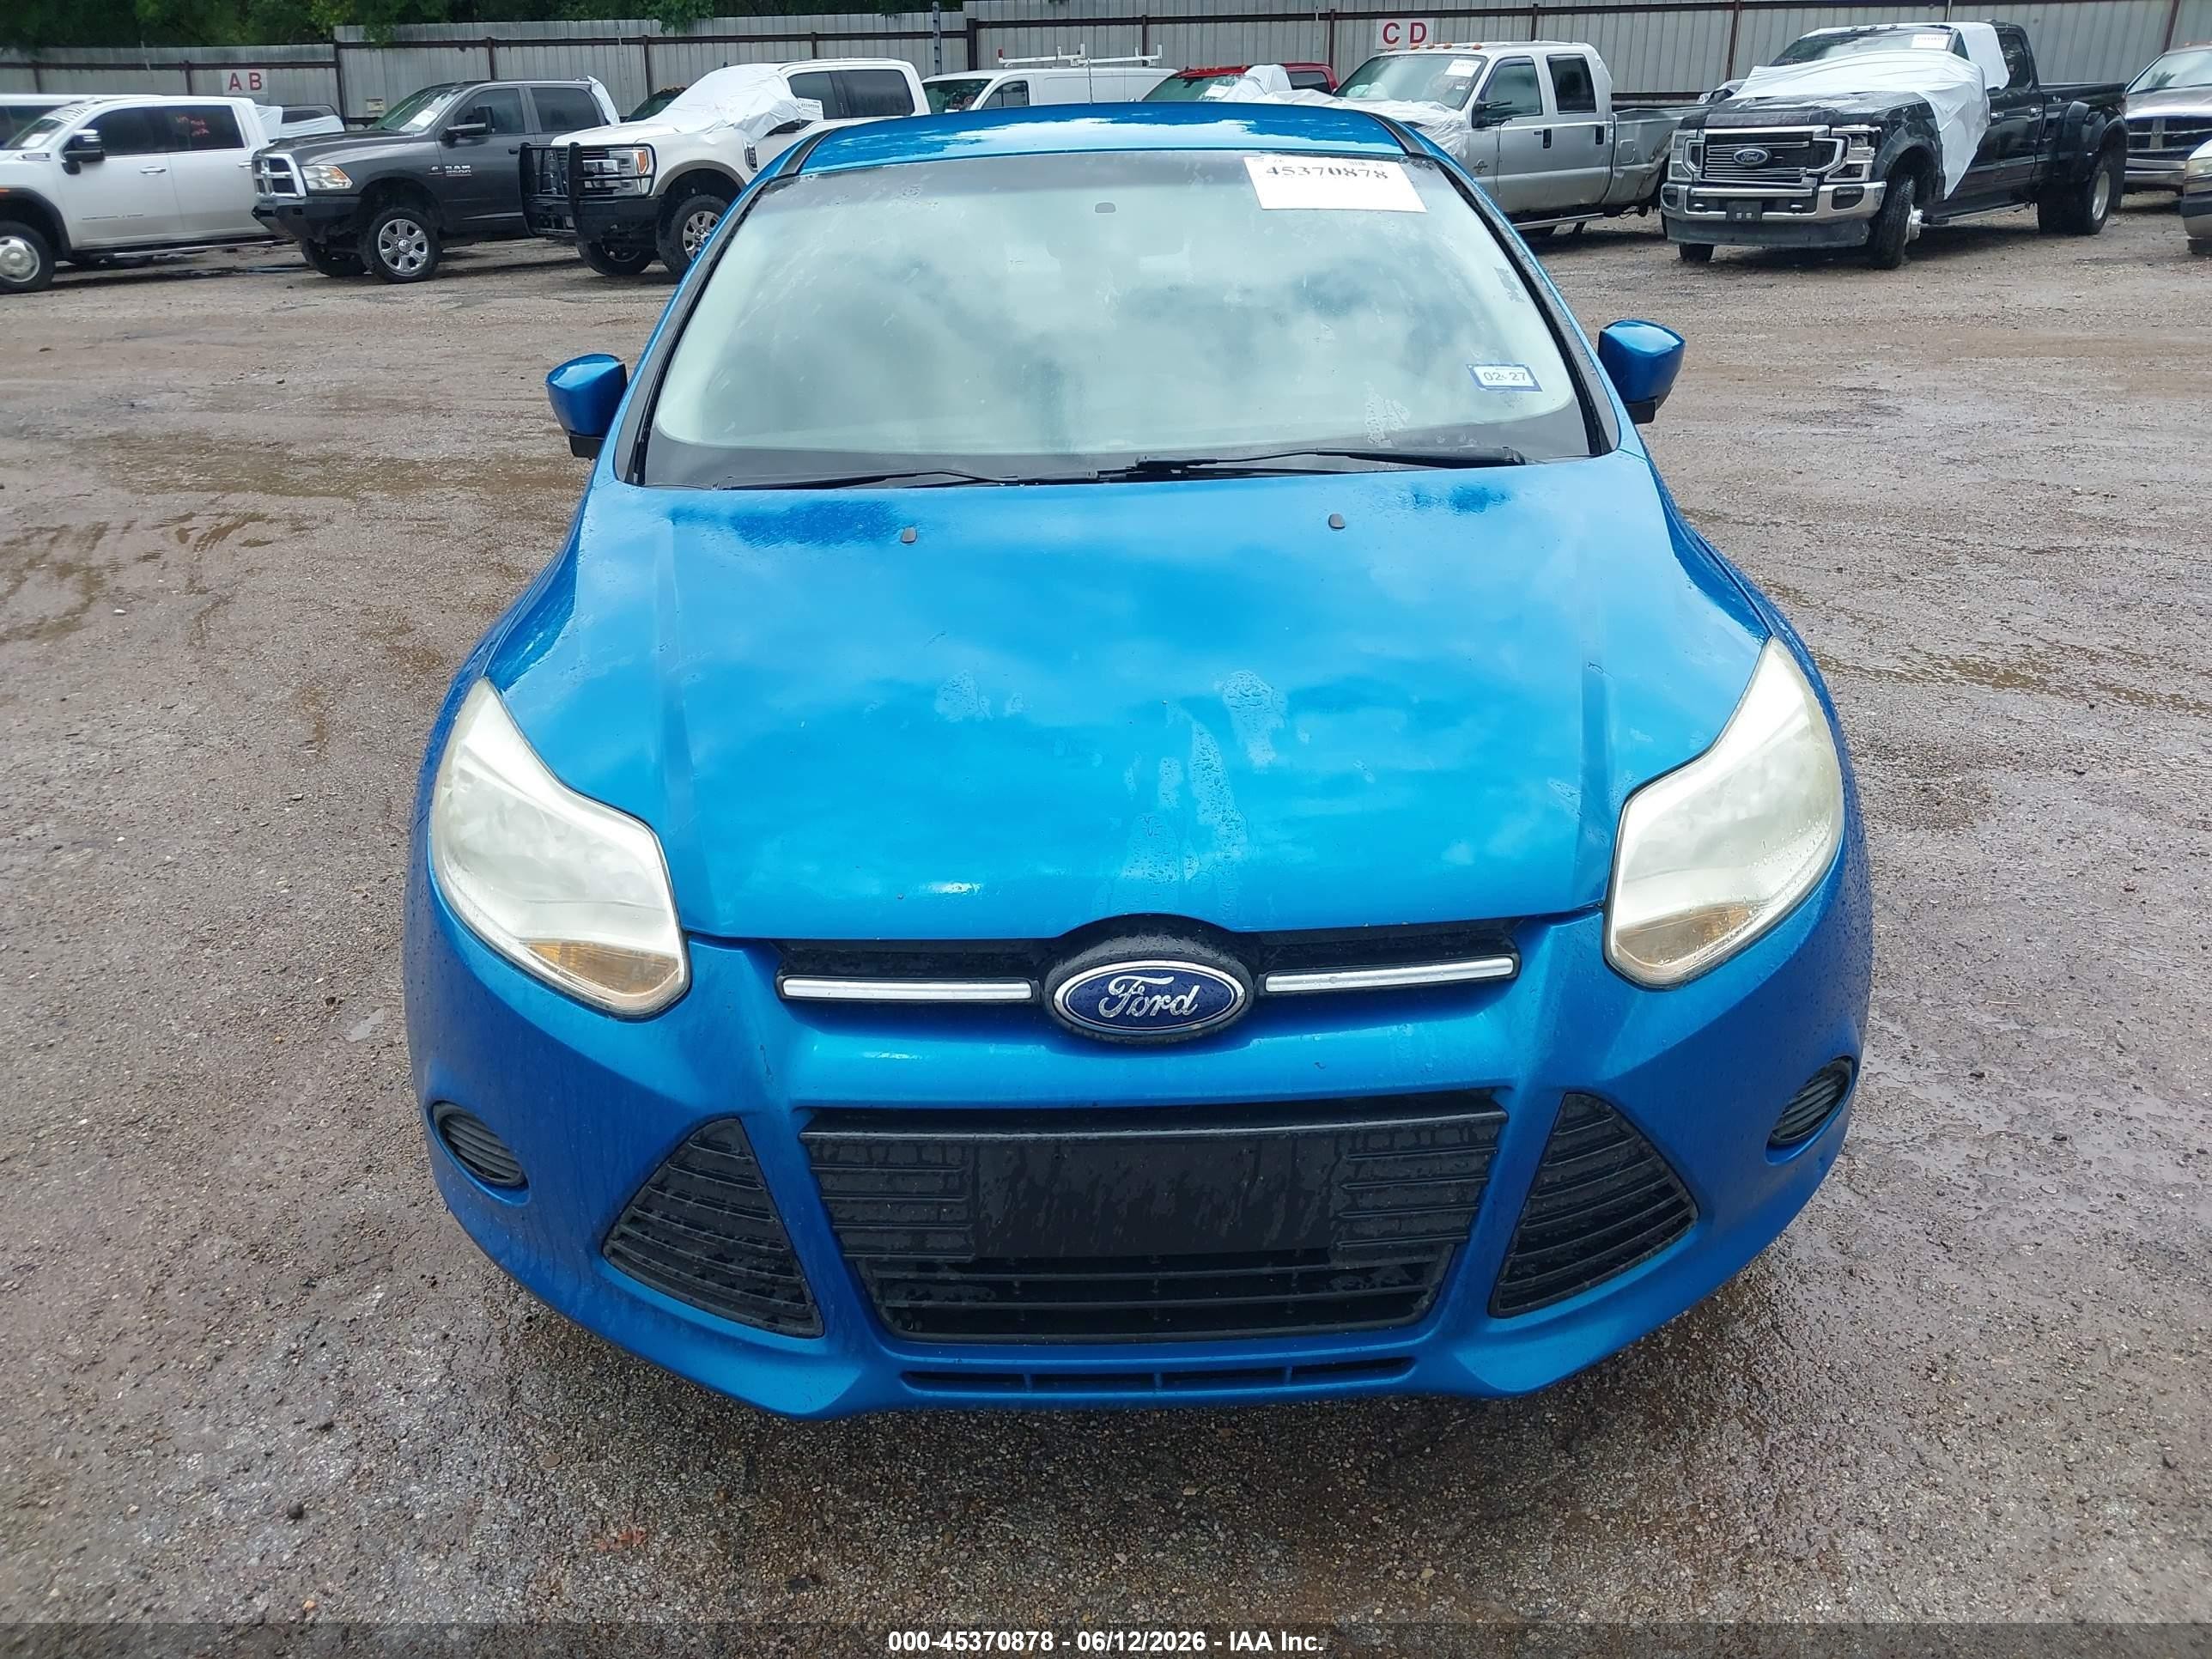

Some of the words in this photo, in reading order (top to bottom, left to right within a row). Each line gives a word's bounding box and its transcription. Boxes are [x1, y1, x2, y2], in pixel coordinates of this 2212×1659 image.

[1382, 22, 1401, 44] C
[1410, 22, 1427, 44] D
[228, 72, 243, 91] A
[249, 72, 263, 91] B
[1266, 165, 1389, 179] 45370878
[1098, 975, 1201, 1018] Ford
